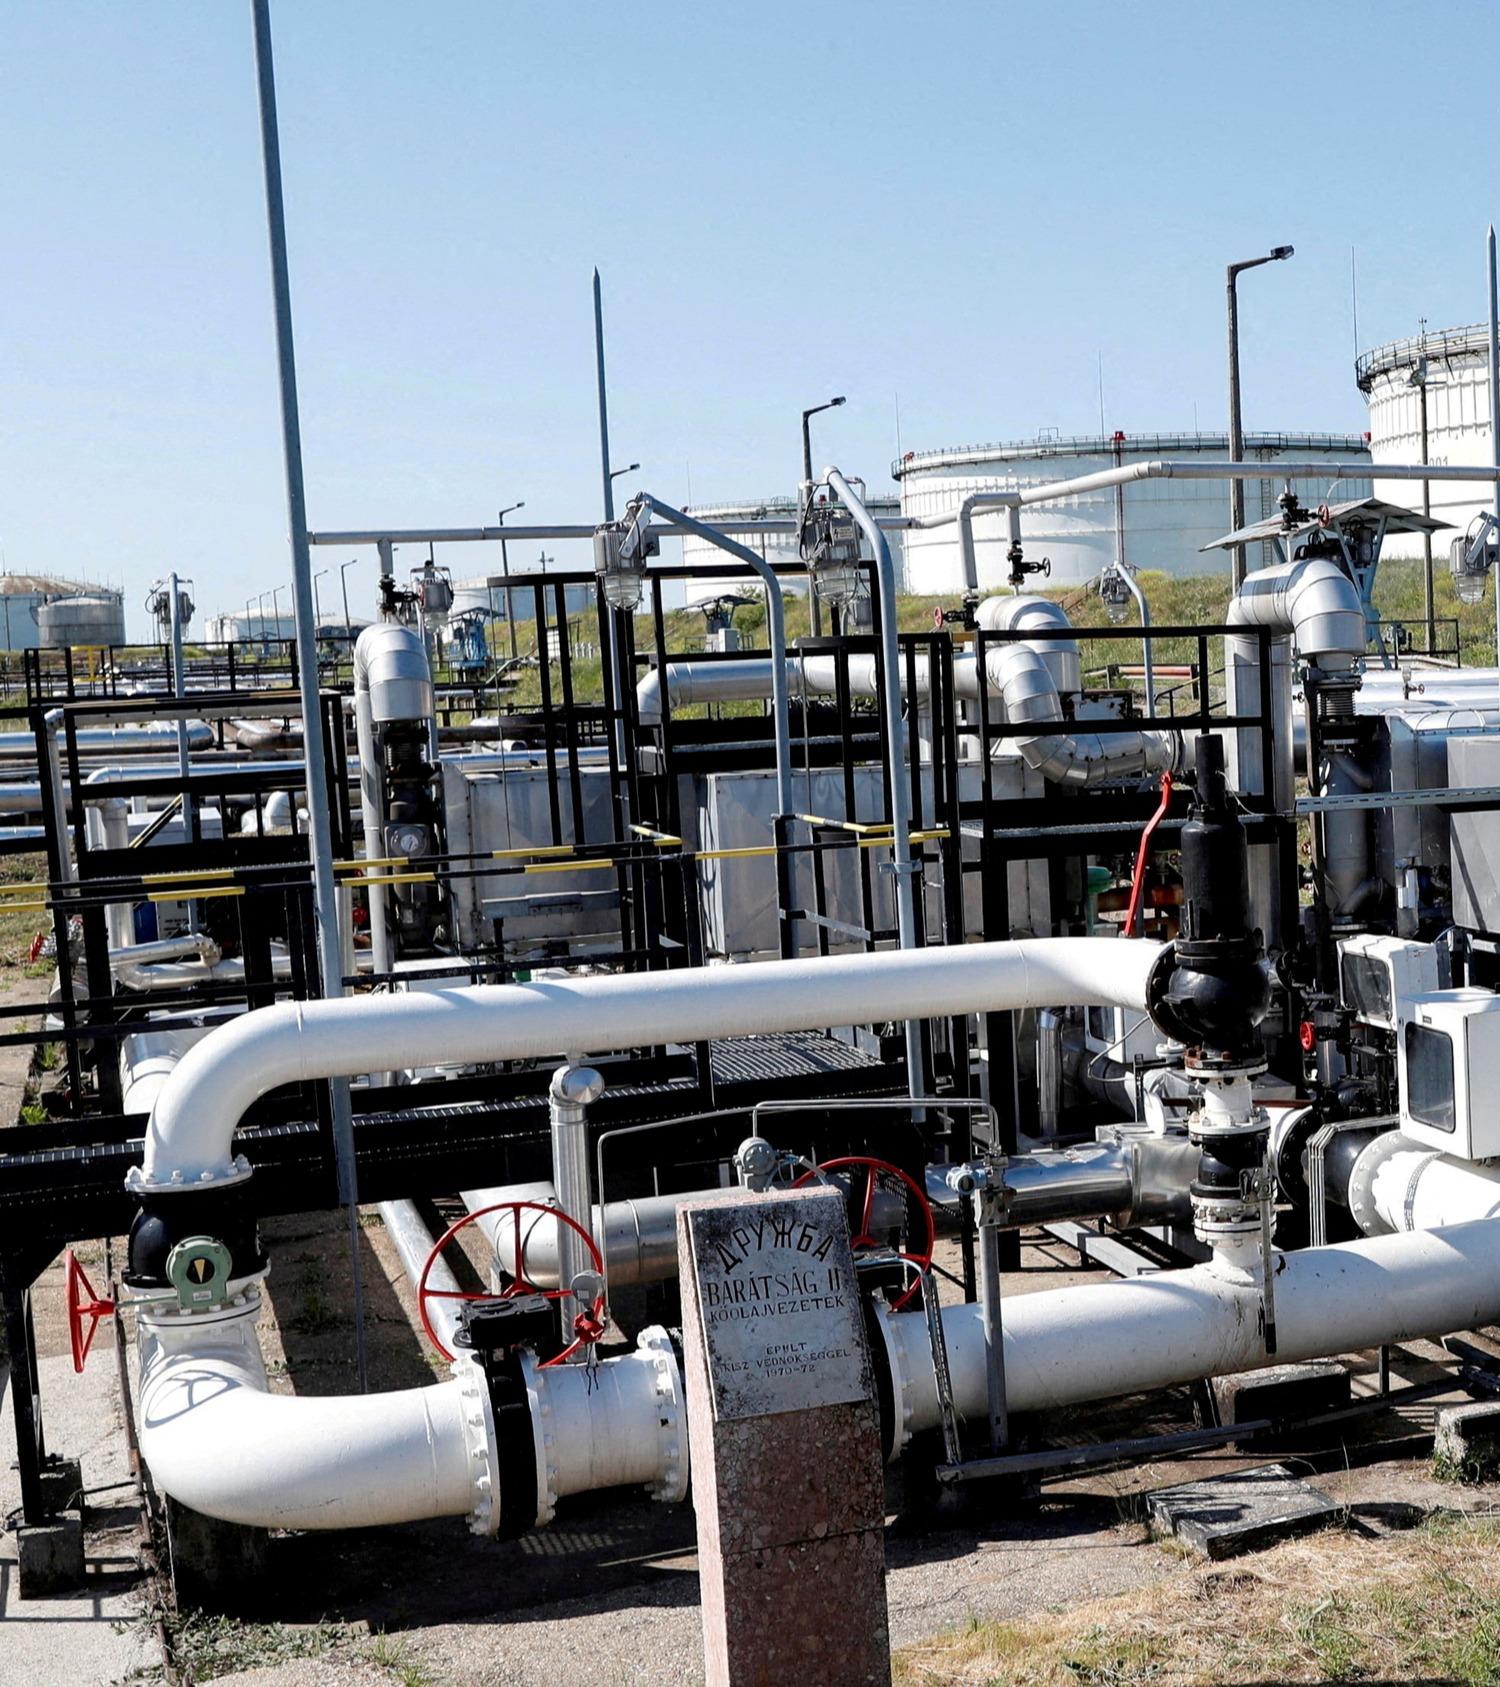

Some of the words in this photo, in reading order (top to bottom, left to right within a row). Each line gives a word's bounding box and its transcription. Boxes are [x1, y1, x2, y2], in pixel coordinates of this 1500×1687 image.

[714, 1218, 835, 1276] ДРУЖБА
[706, 1266, 819, 1307] BARÁTSÁG
[827, 1267, 842, 1292] II
